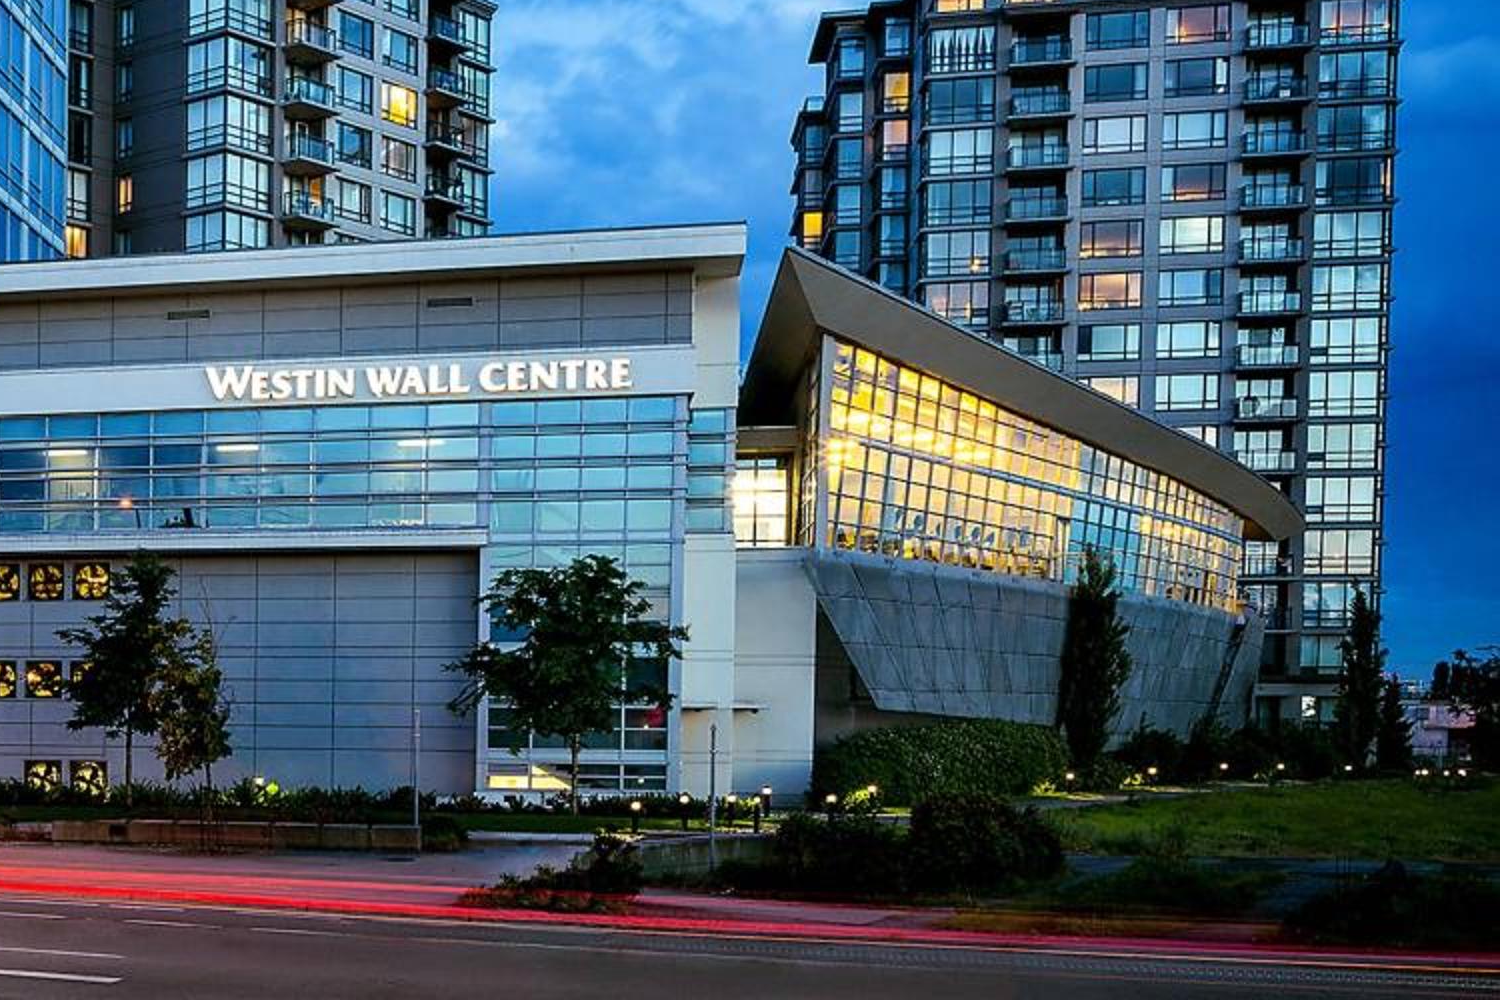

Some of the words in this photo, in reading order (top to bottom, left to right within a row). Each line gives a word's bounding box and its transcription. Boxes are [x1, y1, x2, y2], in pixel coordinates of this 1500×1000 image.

[205, 366, 354, 400] WESTIN
[367, 364, 470, 397] WALL
[479, 359, 632, 393] CENTRE
